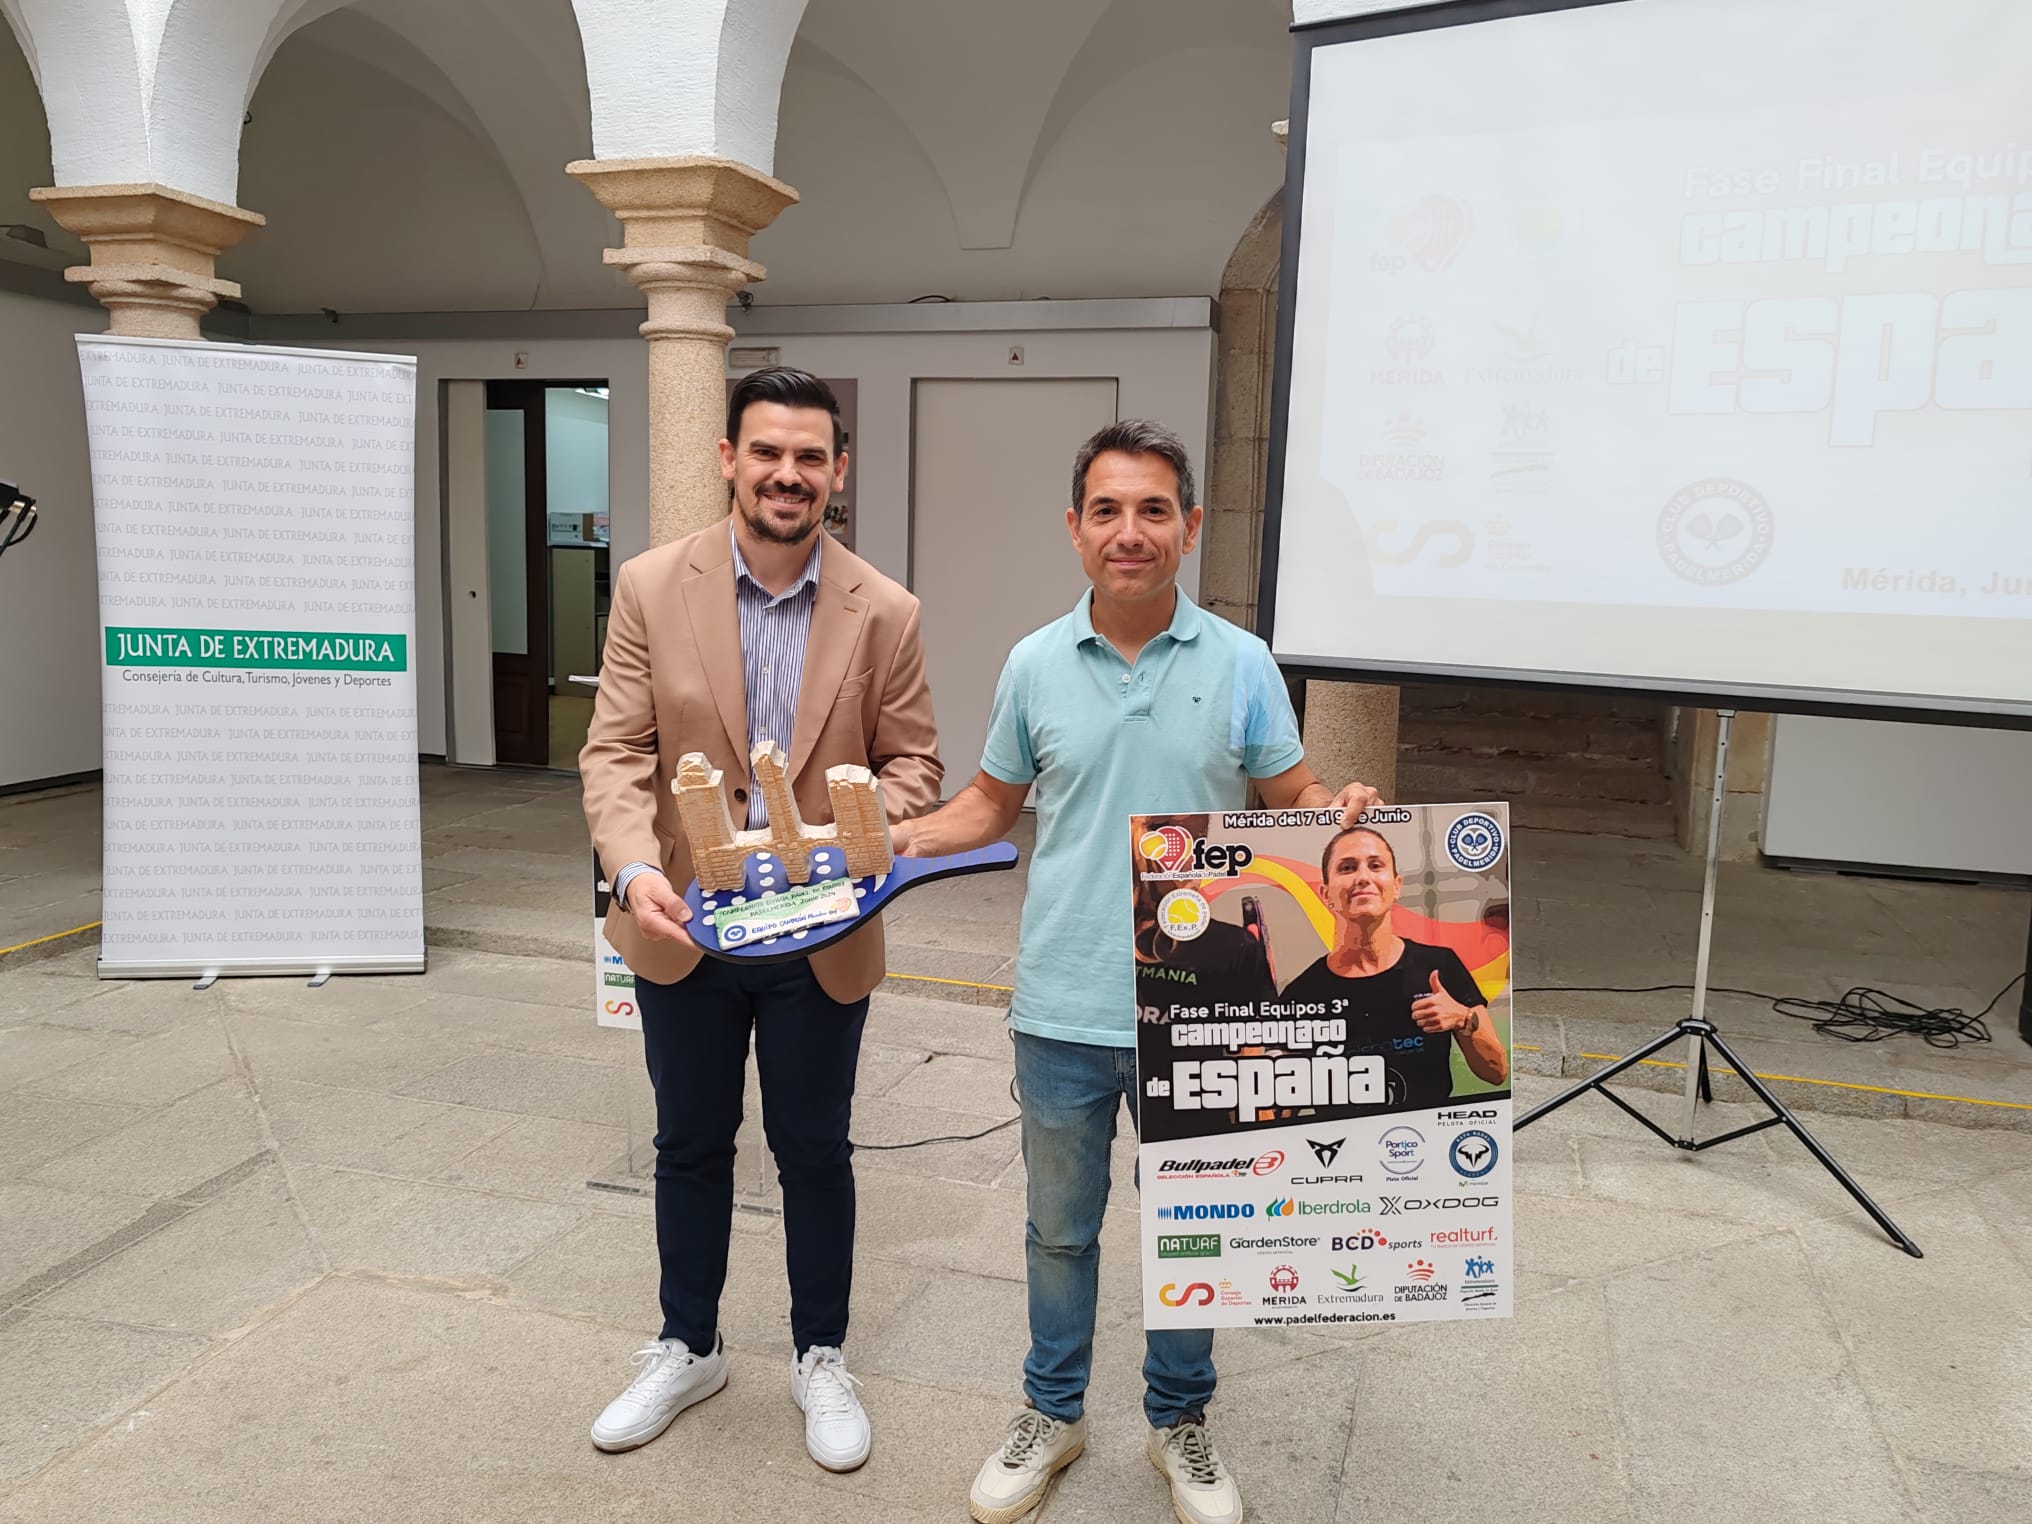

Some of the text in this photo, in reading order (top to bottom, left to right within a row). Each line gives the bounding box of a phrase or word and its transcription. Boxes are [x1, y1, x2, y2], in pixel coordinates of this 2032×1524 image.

[1684, 165, 1781, 200] Fase
[1797, 152, 1899, 192] Final
[161, 354, 195, 368] JUNTA
[198, 357, 210, 369] DE
[213, 358, 289, 373] EXTREMADURA
[116, 376, 128, 388] DE
[132, 377, 209, 392] EXTREMADURA
[217, 381, 249, 395] JUNTA
[253, 384, 265, 396] DE
[268, 385, 343, 401] EXTREMADURA
[347, 390, 379, 402] JUNTA
[164, 403, 197, 417] JUNTA
[200, 405, 212, 417] DE
[215, 406, 290, 422] EXTREMADURA
[298, 410, 330, 424] JUNTA
[333, 413, 345, 424] DE
[122, 426, 135, 438] DE
[138, 426, 214, 441] EXTREMADURA
[220, 431, 252, 444] JUNTA
[255, 433, 267, 445] DE
[270, 434, 345, 448] EXTREMADURA
[352, 438, 383, 450] JUNTA
[166, 452, 199, 465] JUNTA
[201, 455, 214, 466] DE
[216, 455, 292, 470] EXTREMADURA
[300, 459, 332, 472] JUNTA
[1841, 566, 1968, 598] Mérida,
[116, 633, 395, 663] JUNTA DE EXTREMADURA
[122, 669, 183, 686] Consejería
[185, 671, 199, 683] de
[292, 673, 332, 688] Jóvenes
[334, 676, 341, 688] y
[343, 674, 392, 688] Deportes
[175, 703, 207, 717] JUNTA
[210, 705, 222, 716] DE
[224, 705, 298, 718] EXTREMADURA
[305, 706, 337, 719] JUNTA
[1225, 813, 1274, 828] Mérida
[1278, 812, 1301, 826] del
[1304, 812, 1313, 825] 7
[1317, 811, 1331, 824] al
[1371, 808, 1411, 823] Junio
[1463, 817, 1500, 842] DEPORTIVO
[1193, 839, 1253, 876] fep
[1451, 845, 1499, 867] PADELMERIDA
[137, 910, 149, 921] DE
[152, 909, 226, 921] EXTREMADURA
[234, 908, 265, 921] JUNTA
[268, 908, 280, 920] DE
[282, 908, 353, 920] EXTREMADURA
[183, 932, 214, 944] JUNTA
[216, 931, 228, 943] DE
[231, 931, 303, 943] EXTREMADURA
[311, 930, 340, 942] JUNTA
[1170, 999, 1349, 1019] Fase Final Equipos 3ª
[1171, 1019, 1347, 1051] campeonato
[1146, 1044, 1385, 1123] de España
[1438, 1110, 1497, 1120] HEAD
[1389, 1149, 1415, 1159] Sport
[1158, 1157, 1256, 1174] Bullpadel
[1290, 1174, 1363, 1185] CUPRA
[1174, 1203, 1255, 1220] MONDO
[1298, 1199, 1371, 1215] Iberdrola
[1404, 1196, 1499, 1210] OXDOG
[1332, 1236, 1374, 1251] BCD
[1388, 1239, 1422, 1252] sports
[1394, 1281, 1448, 1294] DIPUTACIÓN
[1405, 1292, 1448, 1302] BADAJOZ
[1317, 1292, 1384, 1304] Extremadura
[1254, 1310, 1396, 1327] www.padelfederacion.es
